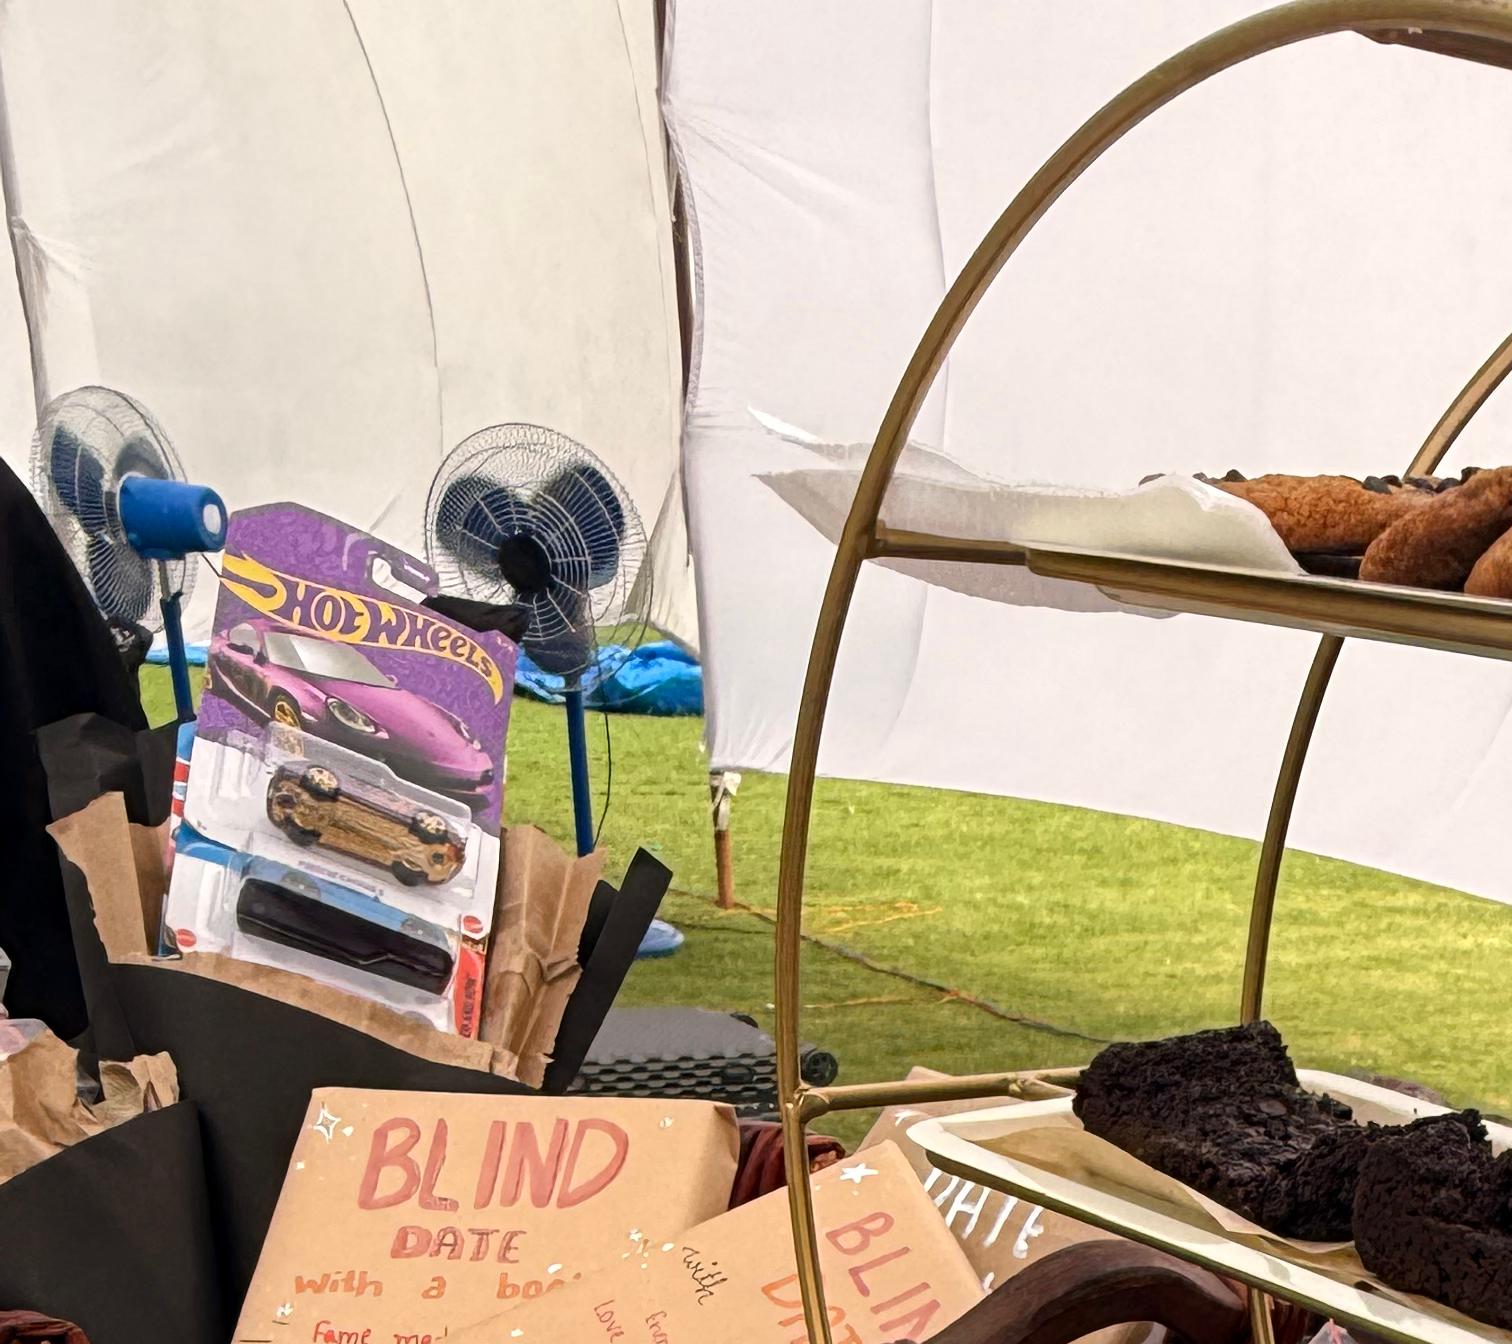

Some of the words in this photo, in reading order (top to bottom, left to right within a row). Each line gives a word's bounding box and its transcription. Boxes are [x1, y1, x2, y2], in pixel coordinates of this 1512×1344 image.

[272, 579, 365, 636] HOT
[357, 1117, 629, 1211] BLIND
[390, 1226, 527, 1264] DATE
[421, 1276, 446, 1299] a
[497, 1272, 582, 1299] bo
[826, 1211, 941, 1344] BLIN
[594, 1299, 625, 1343] Love
